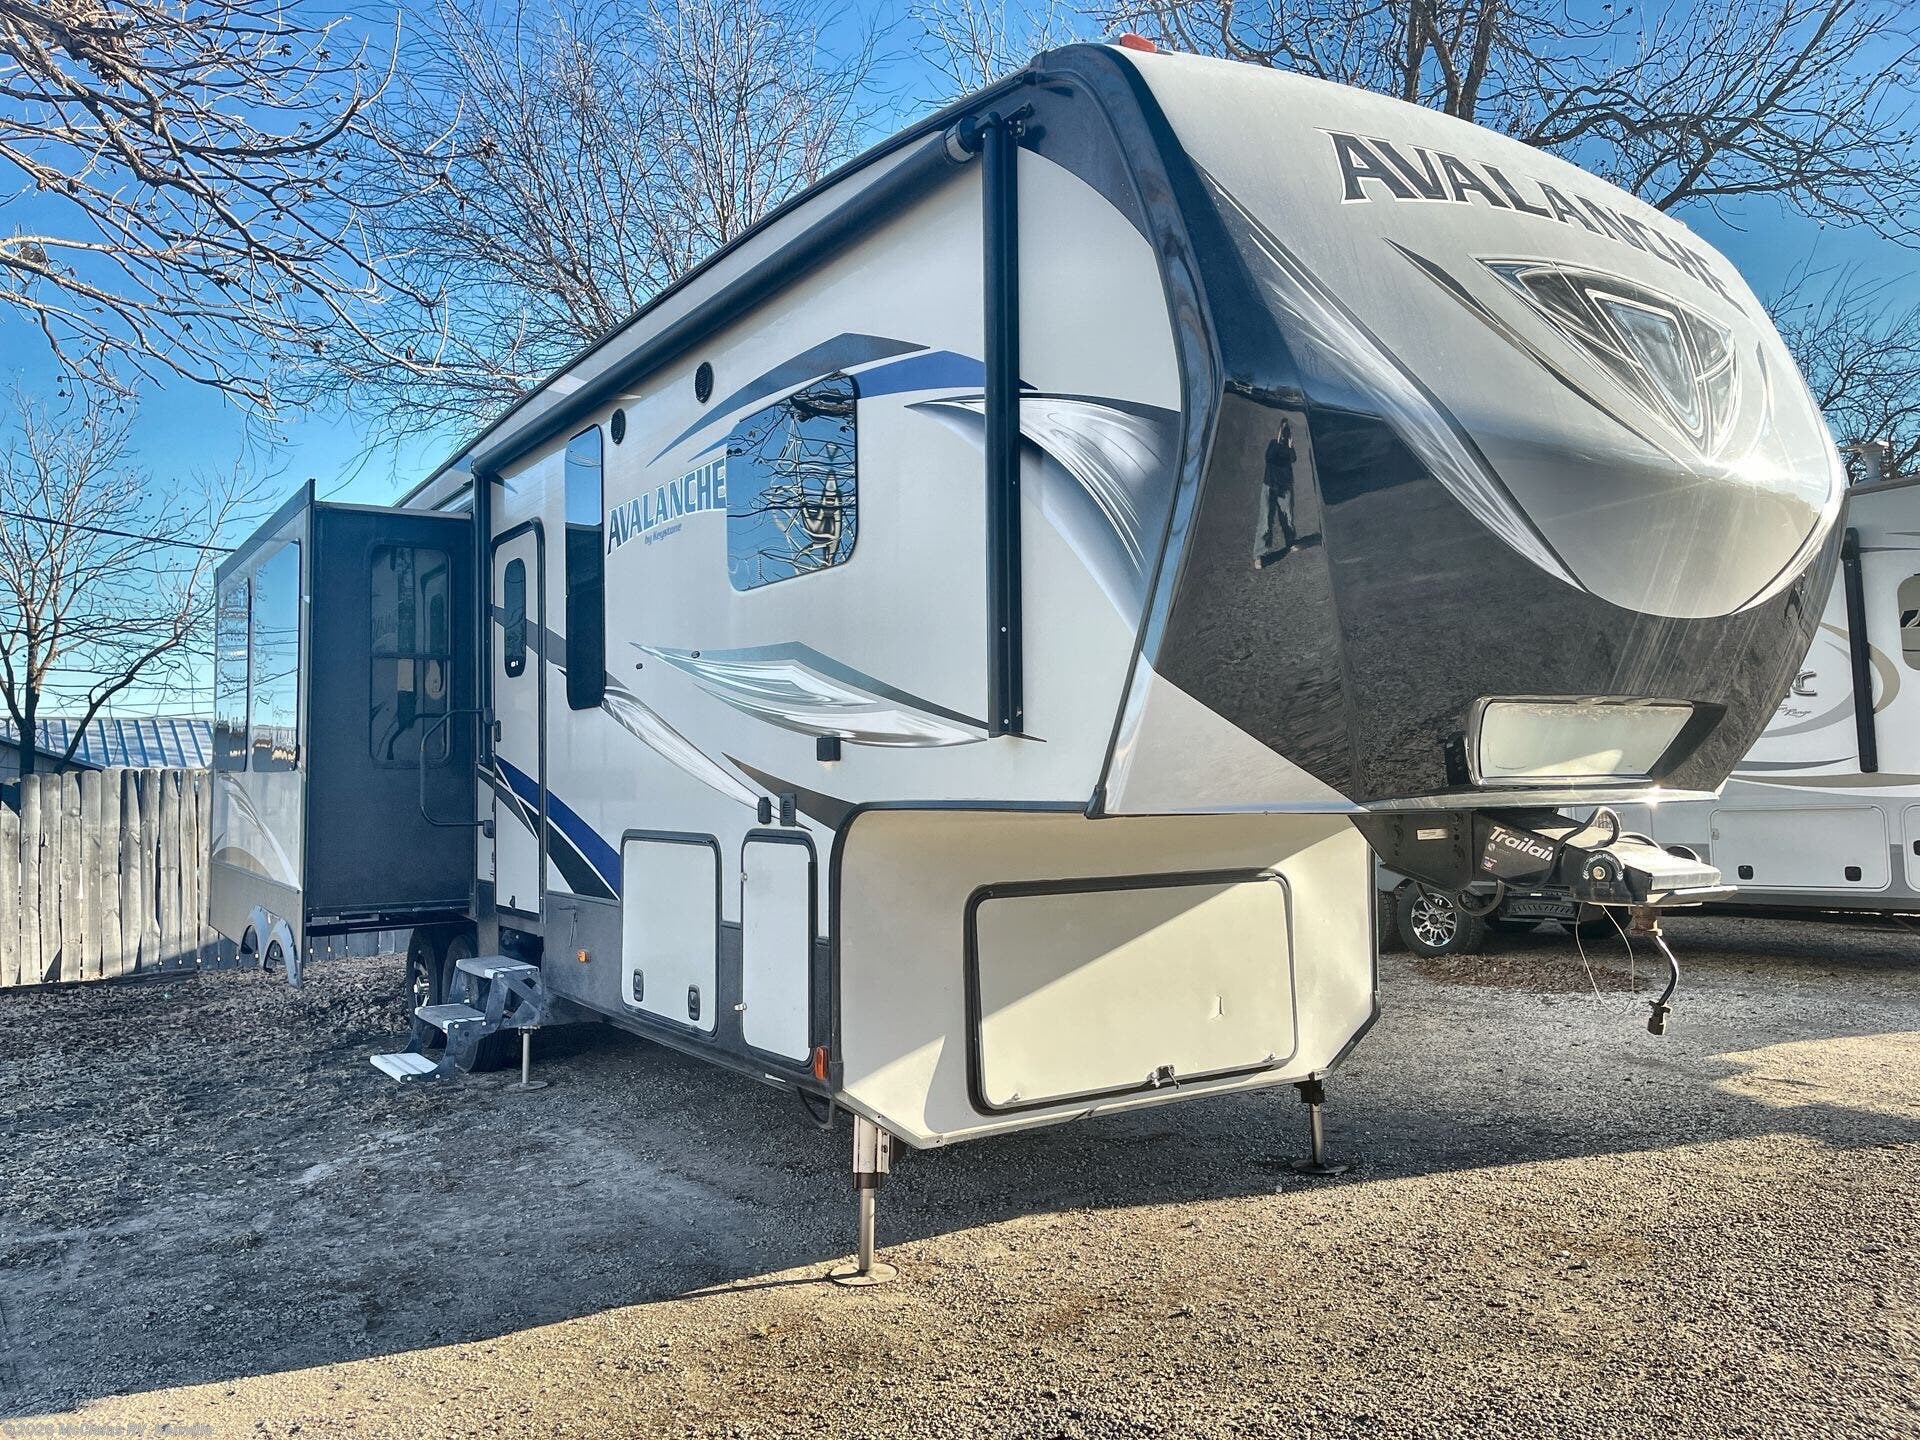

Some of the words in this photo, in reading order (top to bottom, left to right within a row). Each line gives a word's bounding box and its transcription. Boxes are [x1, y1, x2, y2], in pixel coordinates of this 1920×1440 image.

[1316, 127, 1748, 317] AVALANCHE
[606, 456, 727, 557] AVALANCHE
[653, 522, 682, 542] Keystone
